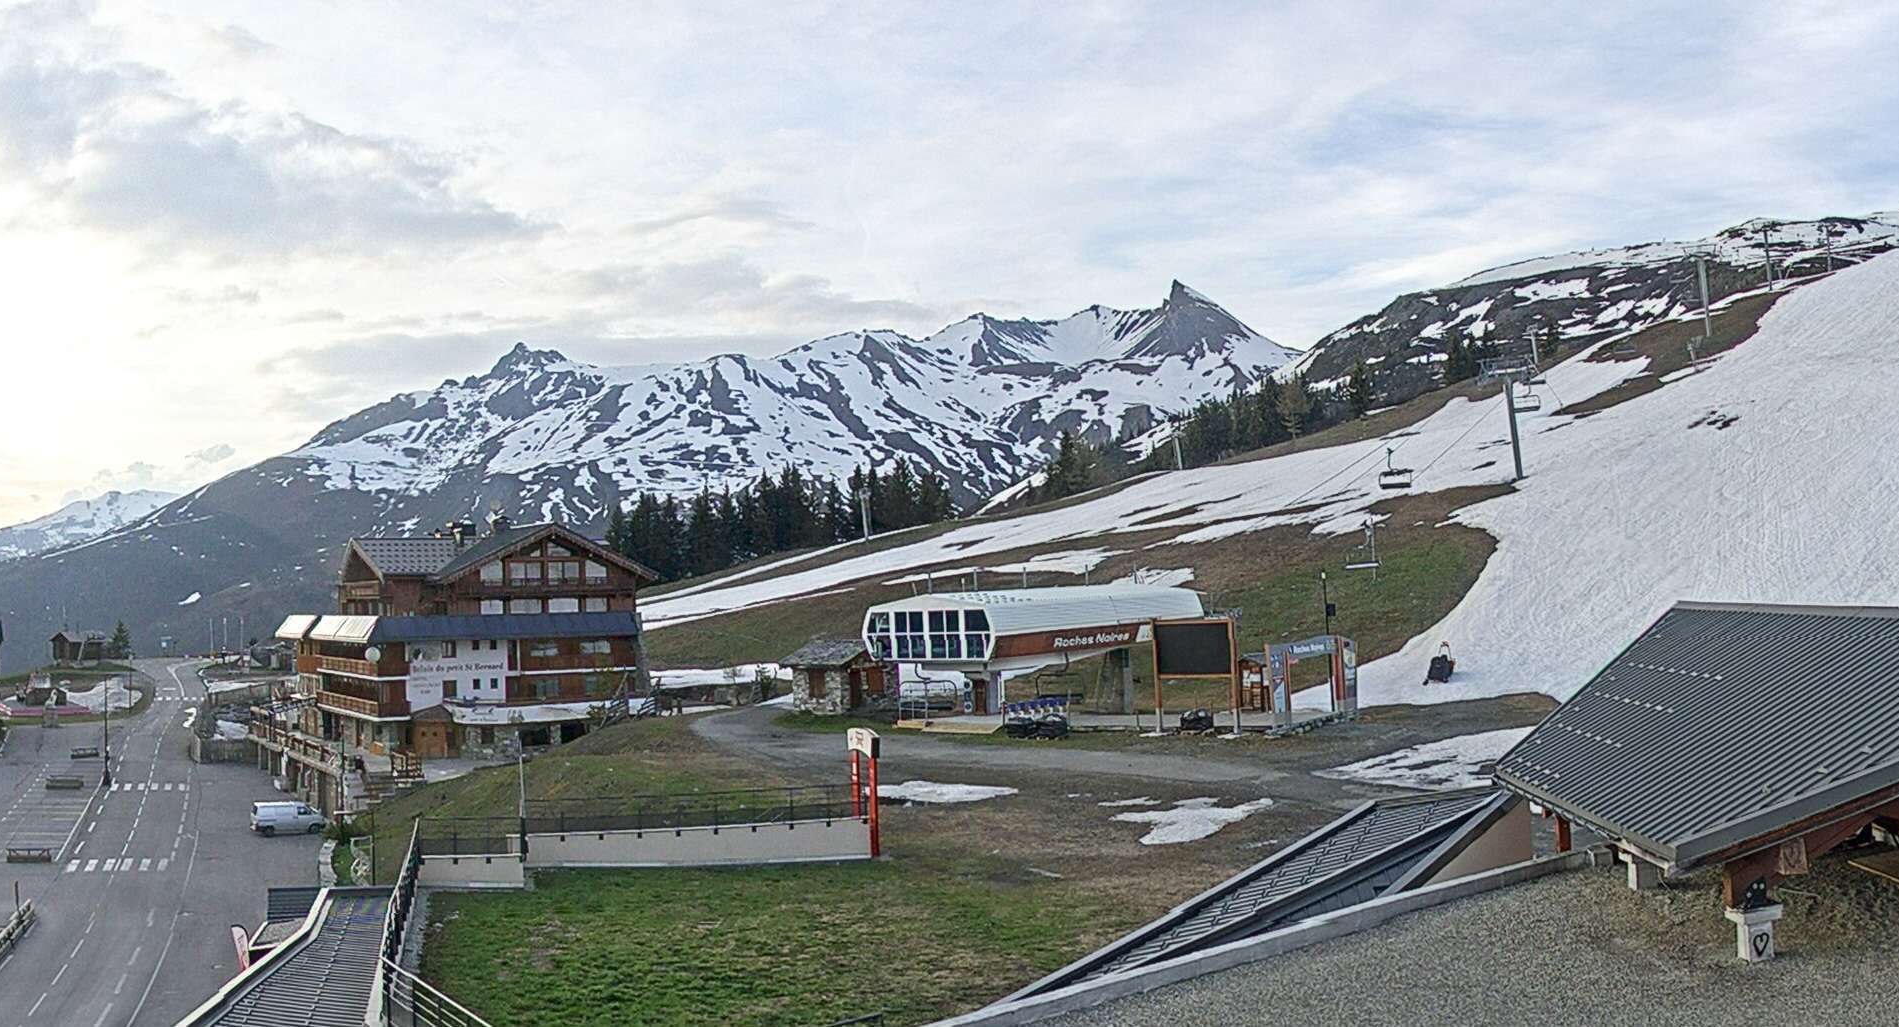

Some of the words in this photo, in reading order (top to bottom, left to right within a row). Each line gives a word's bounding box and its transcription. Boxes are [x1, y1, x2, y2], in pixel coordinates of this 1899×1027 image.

[1053, 635, 1094, 648] Roches
[1095, 632, 1130, 644] Noires
[435, 664, 444, 673] du
[446, 664, 463, 673] petit
[474, 661, 504, 671] Bernard
